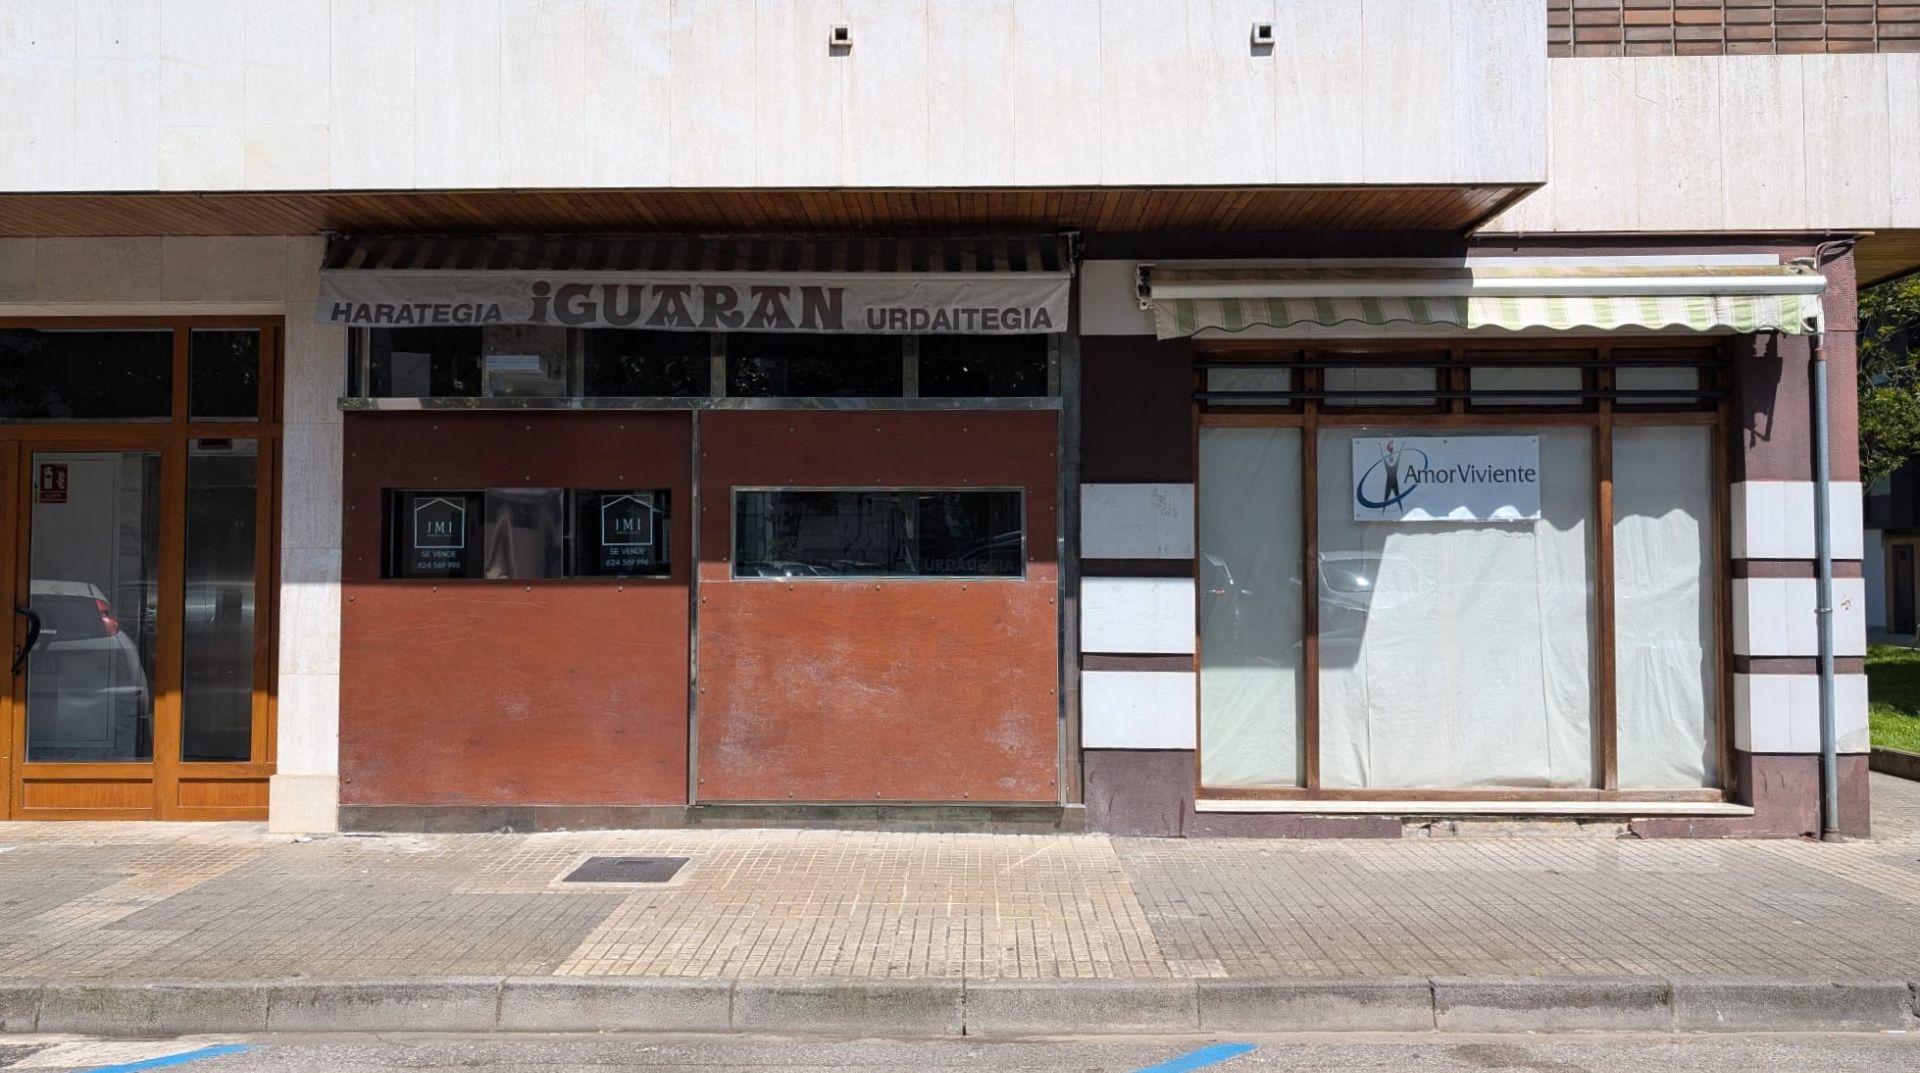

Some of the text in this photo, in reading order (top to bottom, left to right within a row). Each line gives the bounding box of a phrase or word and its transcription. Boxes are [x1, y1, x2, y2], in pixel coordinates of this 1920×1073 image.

[330, 302, 502, 325] HARATEGIA
[866, 306, 1053, 331] URDAITEGIA
[421, 550, 457, 558] SE VENDE
[609, 547, 645, 555] SE VENDE
